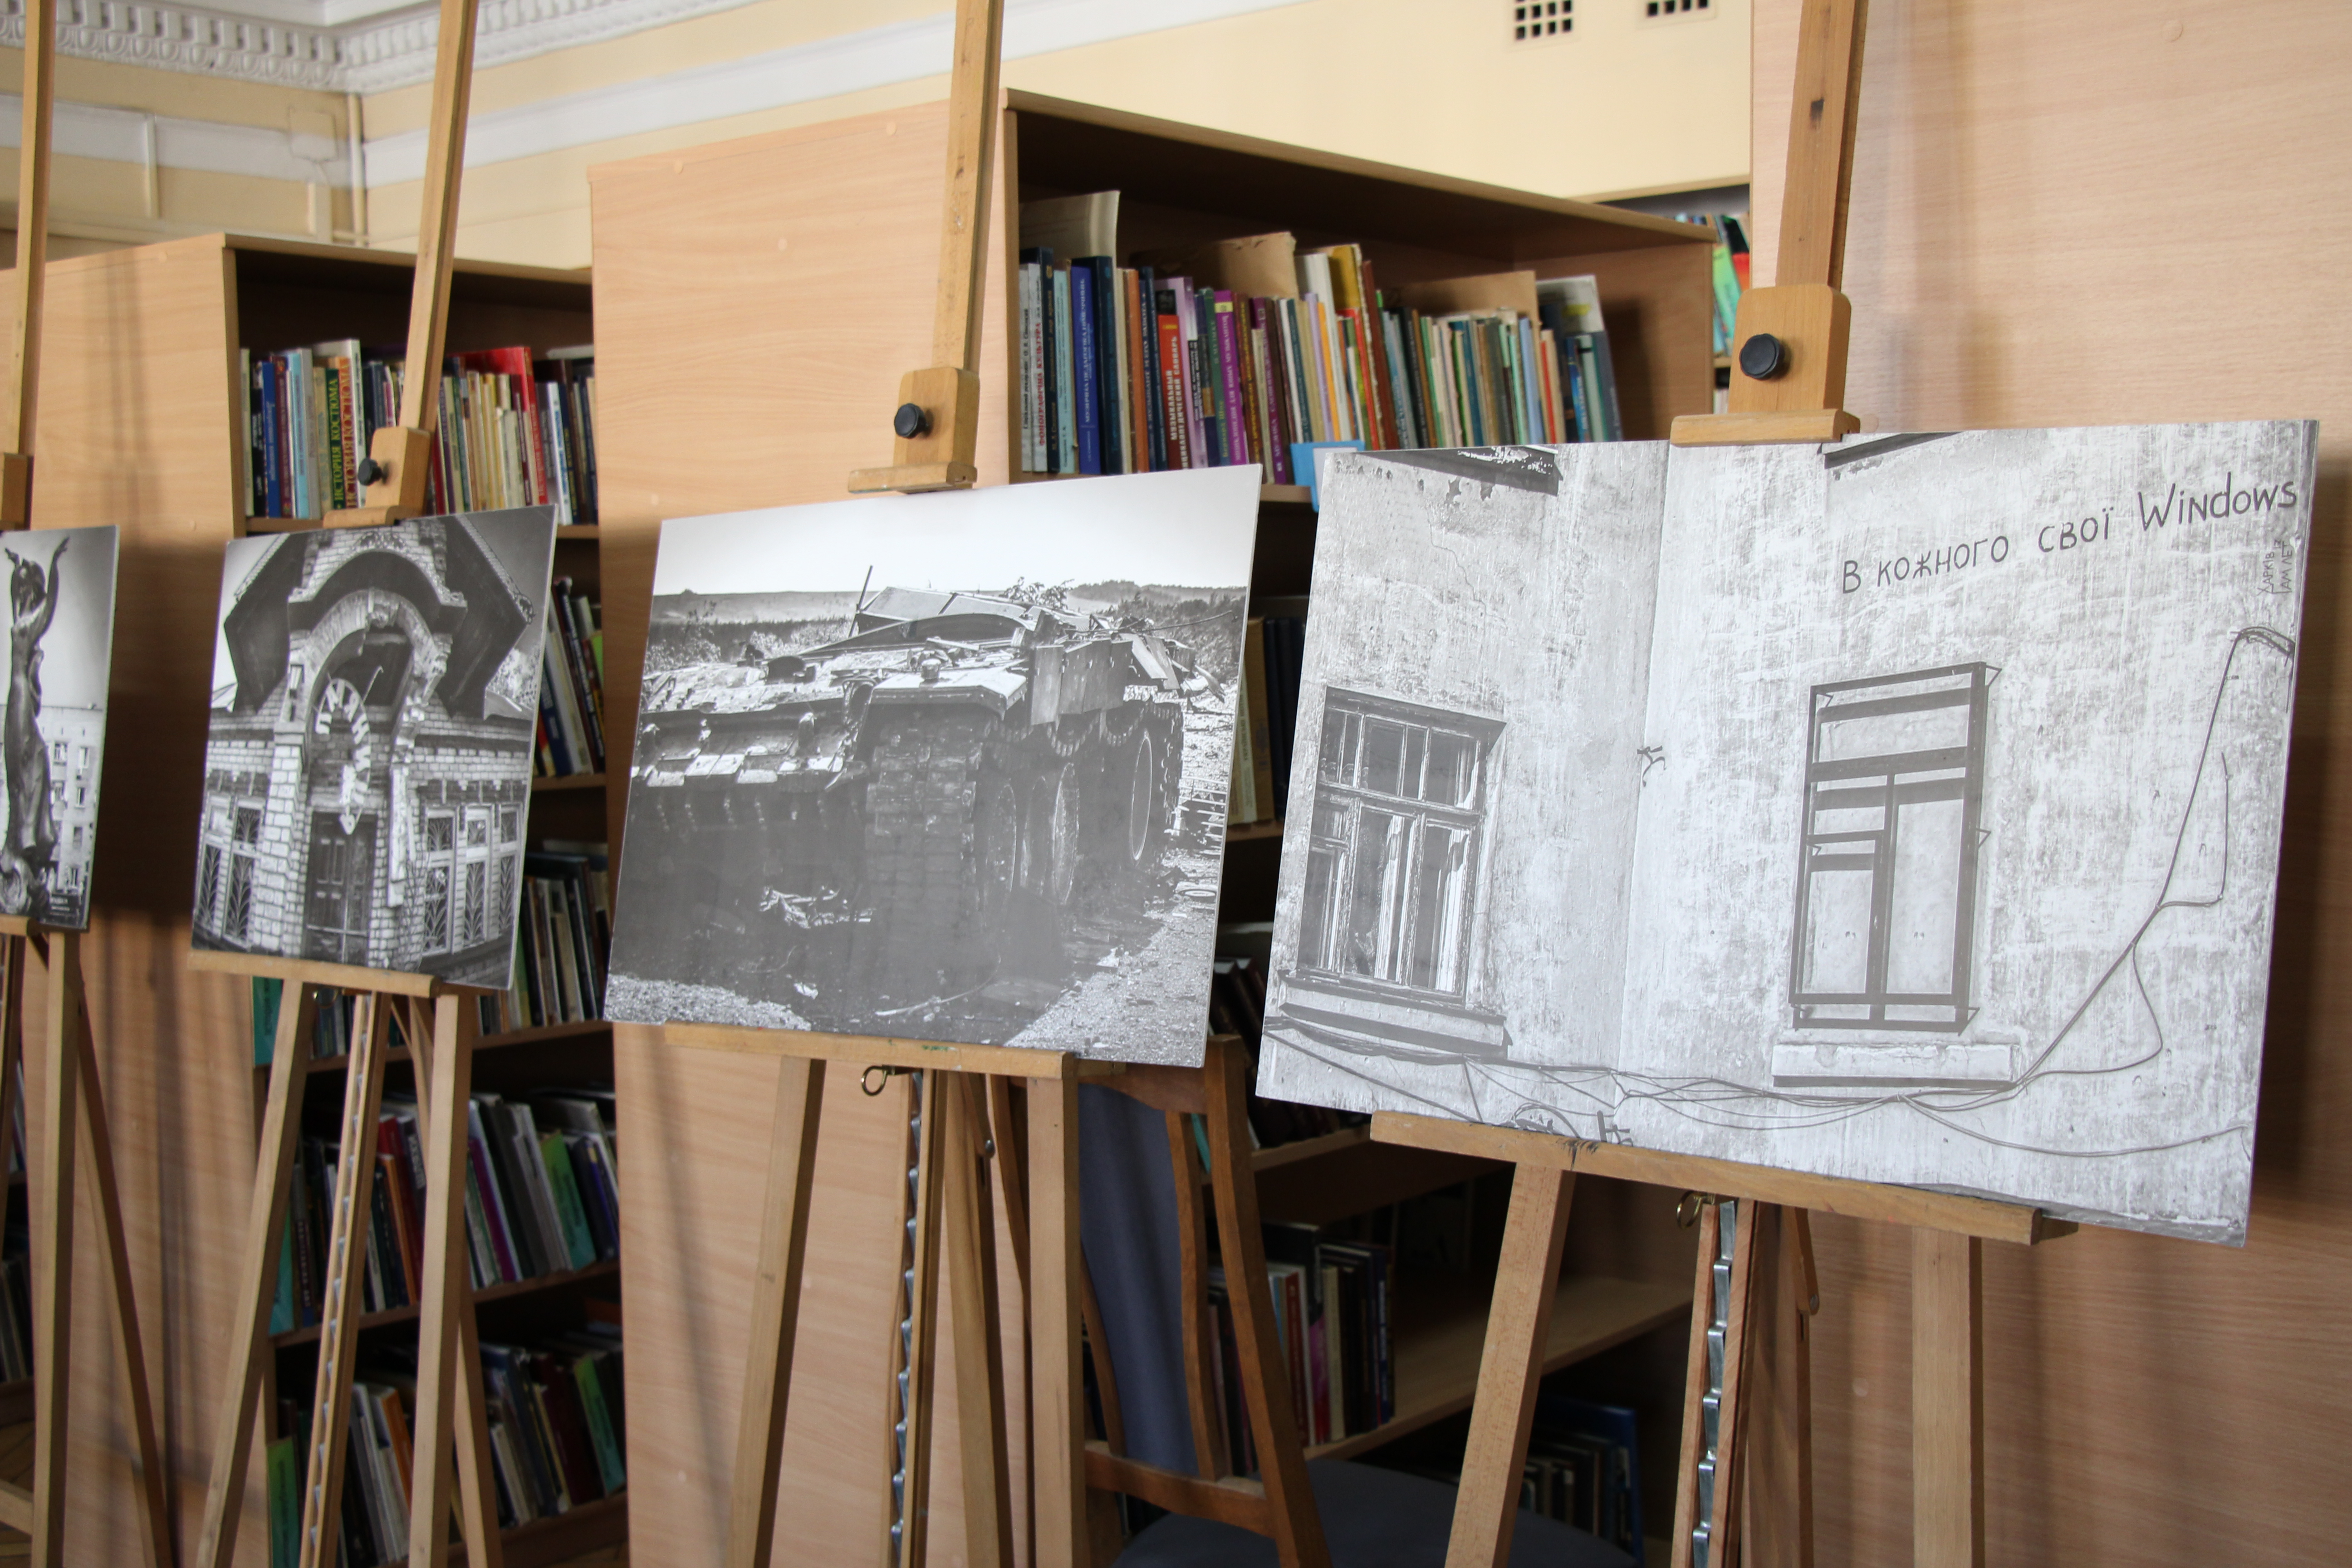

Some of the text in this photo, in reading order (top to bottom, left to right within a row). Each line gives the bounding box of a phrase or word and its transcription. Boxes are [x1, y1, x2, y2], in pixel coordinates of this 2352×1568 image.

[1171, 336, 1180, 375] СЛОВАРЬ
[1166, 370, 1178, 440] МУЗЫКАЛЬНЫЙ
[329, 379, 344, 501] ИСТОРИЯ КОСТЮМА
[1842, 560, 1861, 594] В
